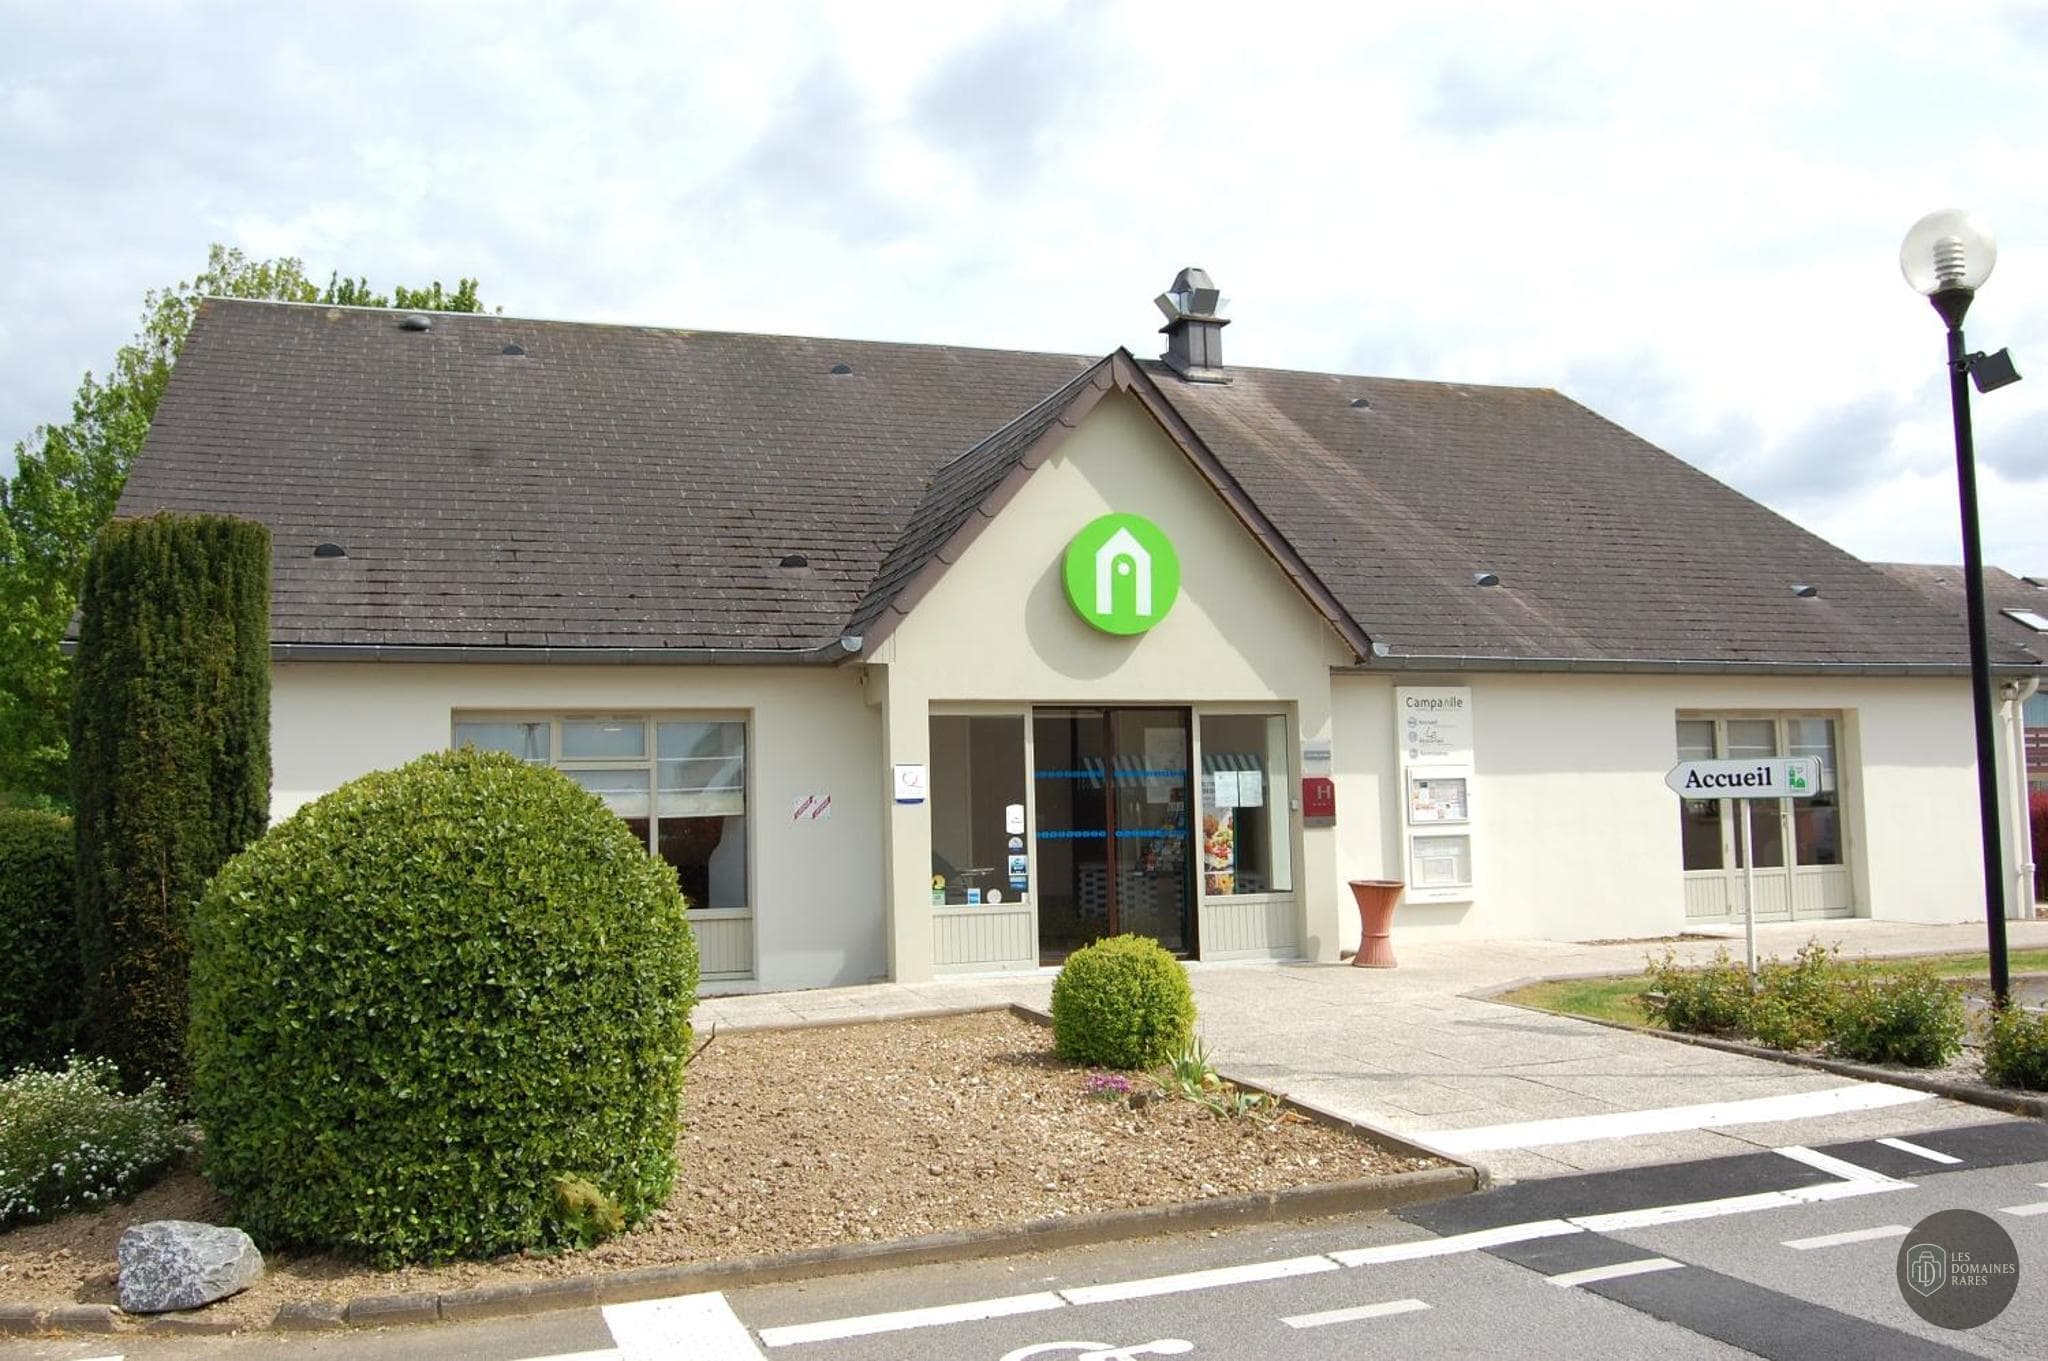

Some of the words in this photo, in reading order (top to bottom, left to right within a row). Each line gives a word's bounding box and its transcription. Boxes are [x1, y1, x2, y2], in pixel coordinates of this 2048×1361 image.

[1406, 695, 1464, 711] Campanile
[1685, 766, 1773, 789] Accueil
[1317, 785, 1331, 800] H
